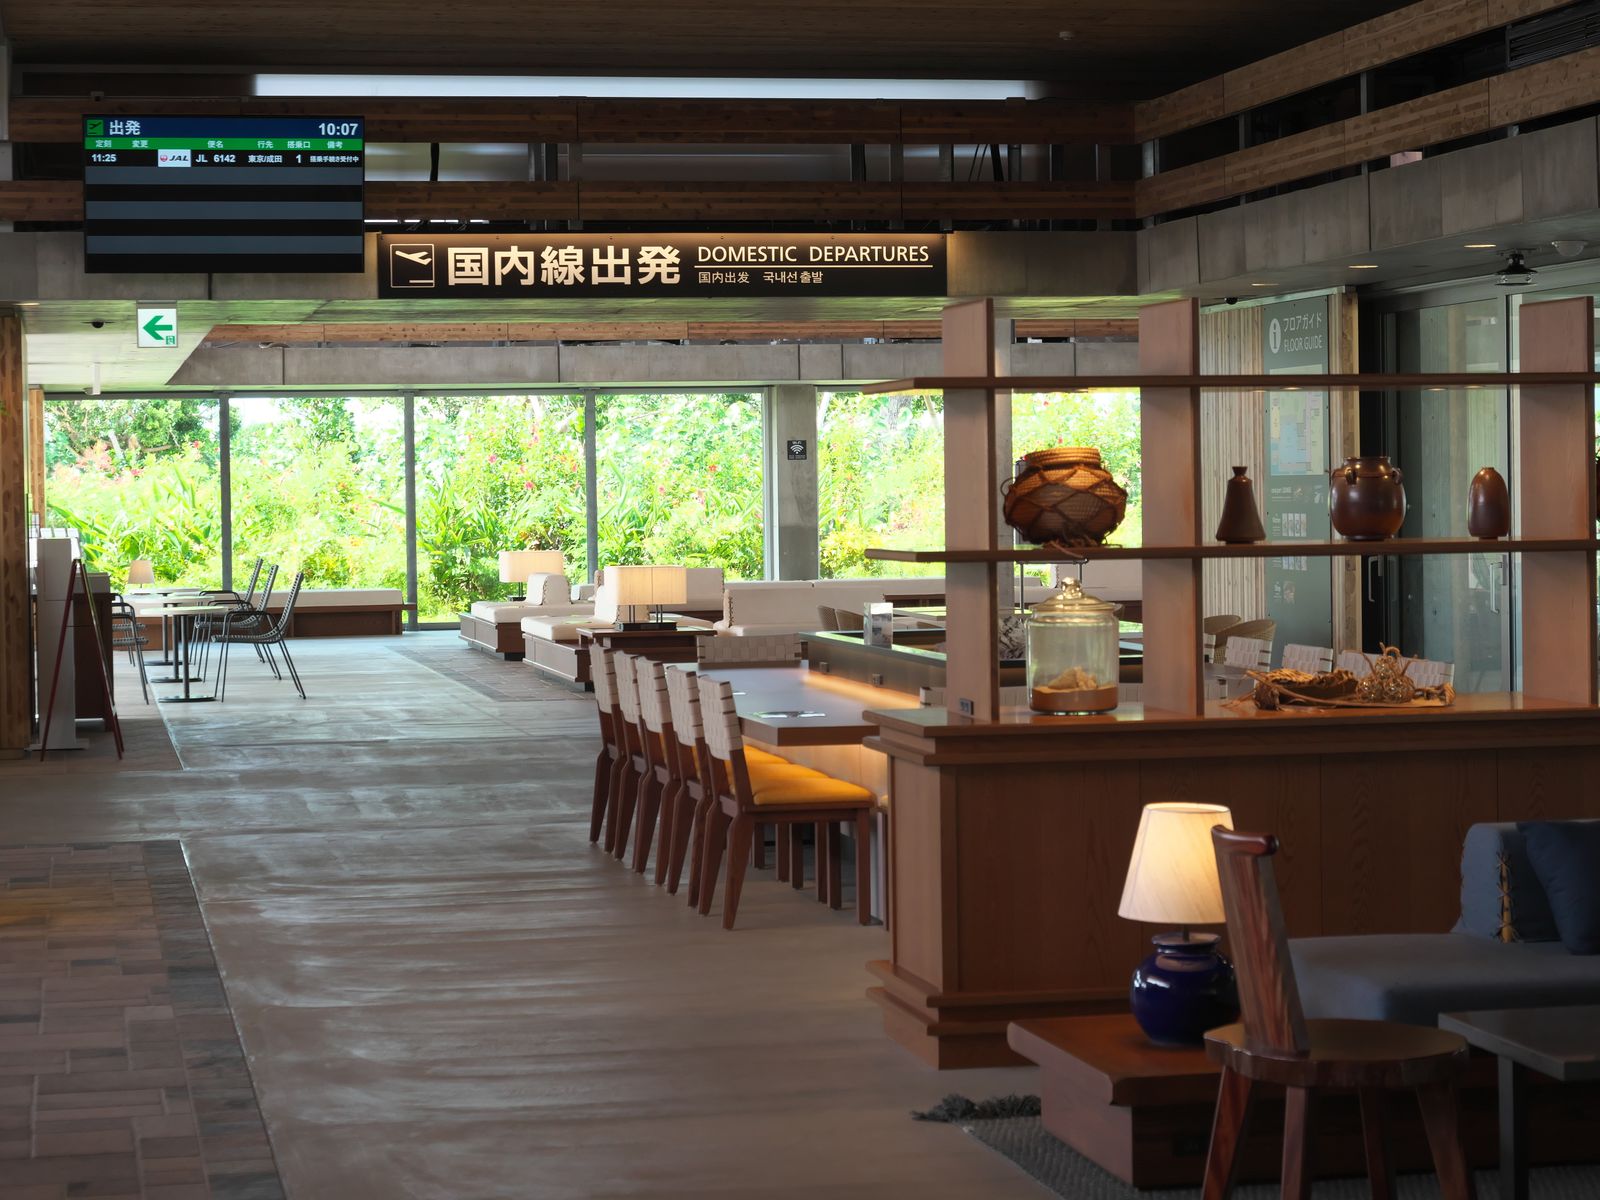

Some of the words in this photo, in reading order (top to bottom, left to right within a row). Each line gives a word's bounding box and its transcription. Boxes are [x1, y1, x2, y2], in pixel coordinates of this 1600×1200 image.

[109, 120, 141, 136] 出発
[318, 123, 358, 136] 10:07
[95, 140, 112, 148] 定刻
[132, 140, 149, 148] 変更
[207, 140, 224, 148] 便名
[257, 140, 274, 149] 行先
[326, 140, 343, 149] 備考
[91, 154, 117, 162] 11:25
[195, 155, 208, 163] JL
[213, 154, 236, 163] 6142
[248, 155, 283, 163] 東京/成田
[295, 155, 302, 163] 1
[698, 246, 797, 262] DOMESTIC
[809, 246, 929, 262] DEPARTURES
[447, 245, 681, 286] 国内線出発
[698, 271, 750, 284] 国内出发
[762, 271, 798, 284] 국내선
[799, 271, 824, 284] 출발
[1283, 311, 1322, 332] フロアガイド
[1284, 337, 1304, 352] FLOOR
[1304, 335, 1322, 350] GUIDE
